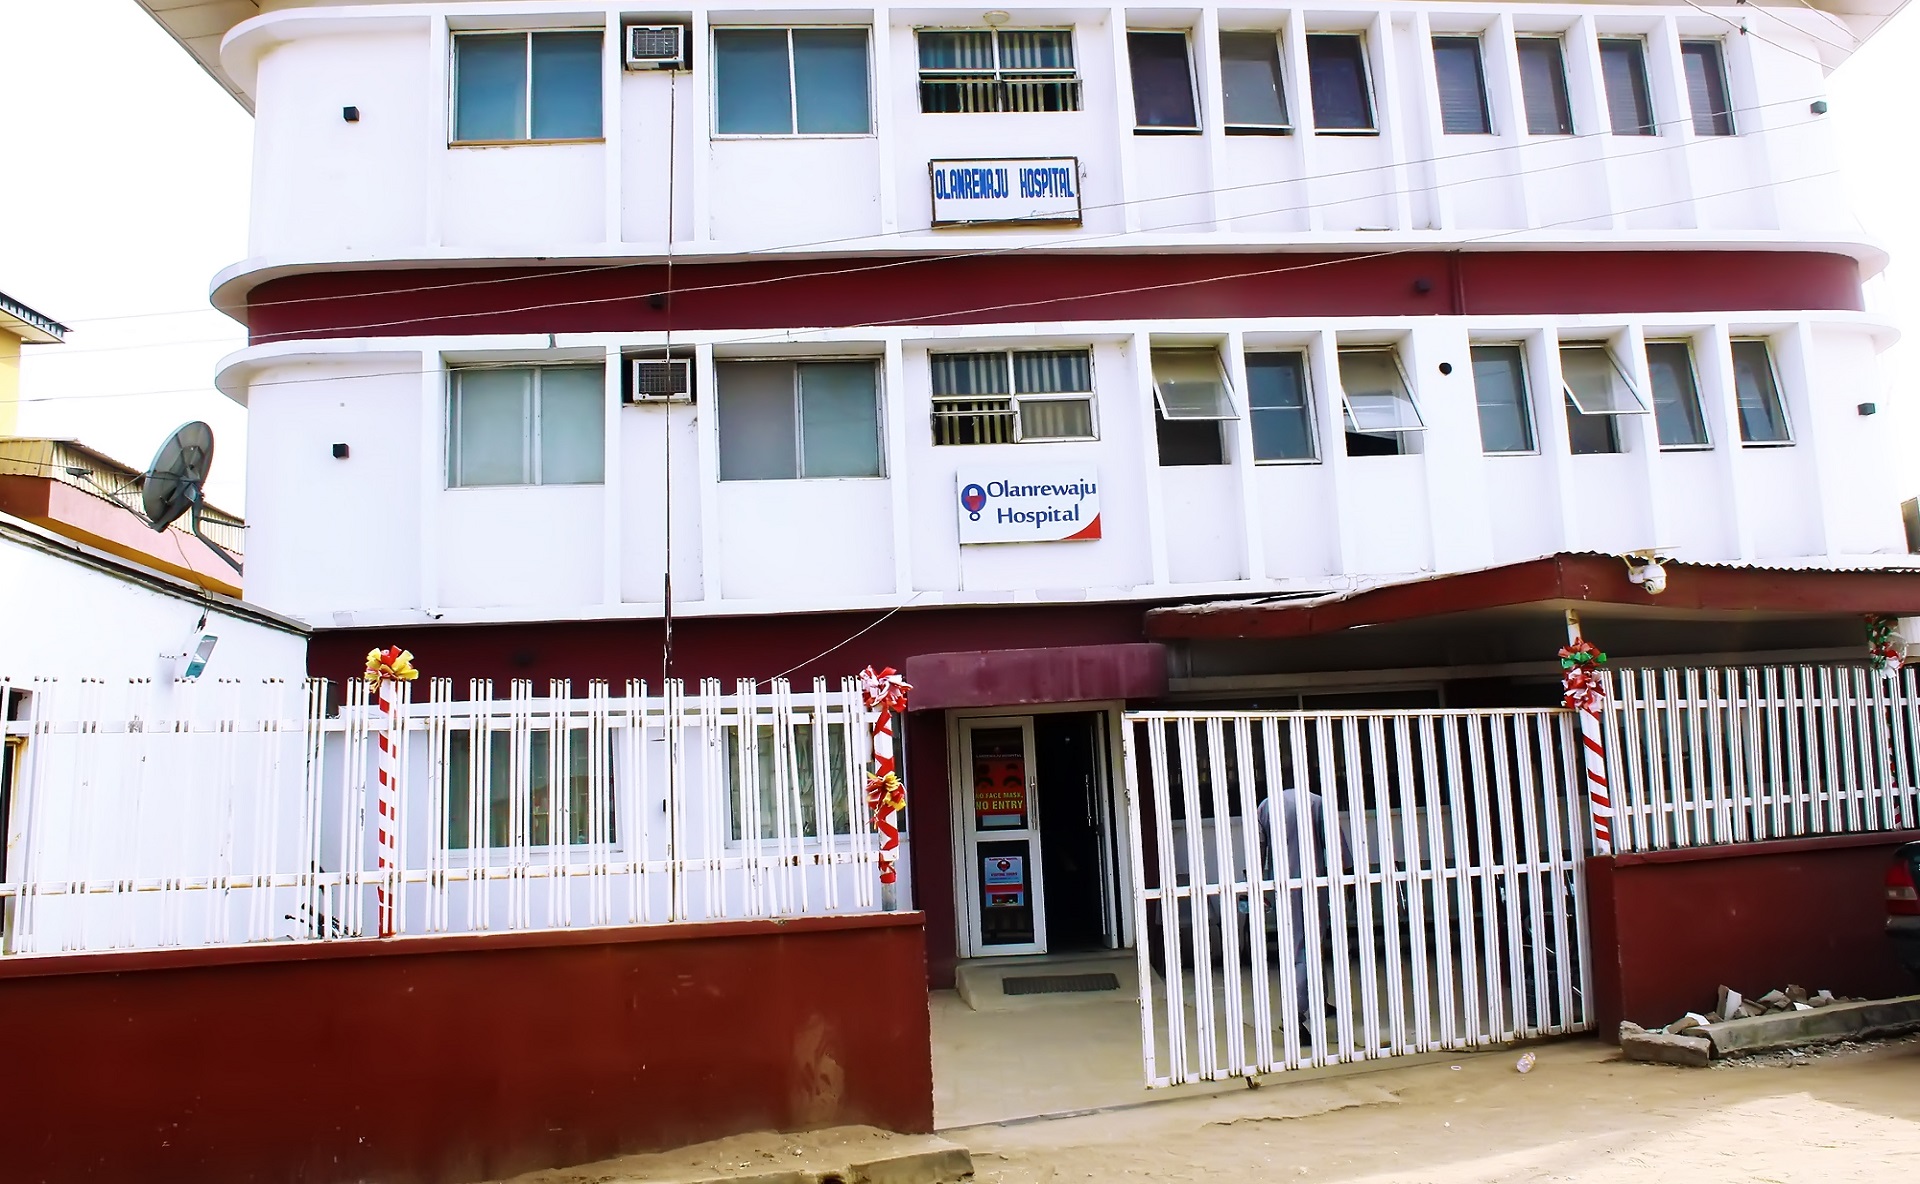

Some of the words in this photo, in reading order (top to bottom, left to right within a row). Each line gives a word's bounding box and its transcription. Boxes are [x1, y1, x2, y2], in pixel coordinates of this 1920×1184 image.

[935, 168, 1009, 200] OLANREWAJU
[1019, 167, 1075, 199] HOSPITAL
[986, 478, 1097, 501] Olanrewaju
[997, 504, 1080, 529] Hospital
[975, 801, 989, 810] NO
[992, 800, 1023, 810] ENTRY
